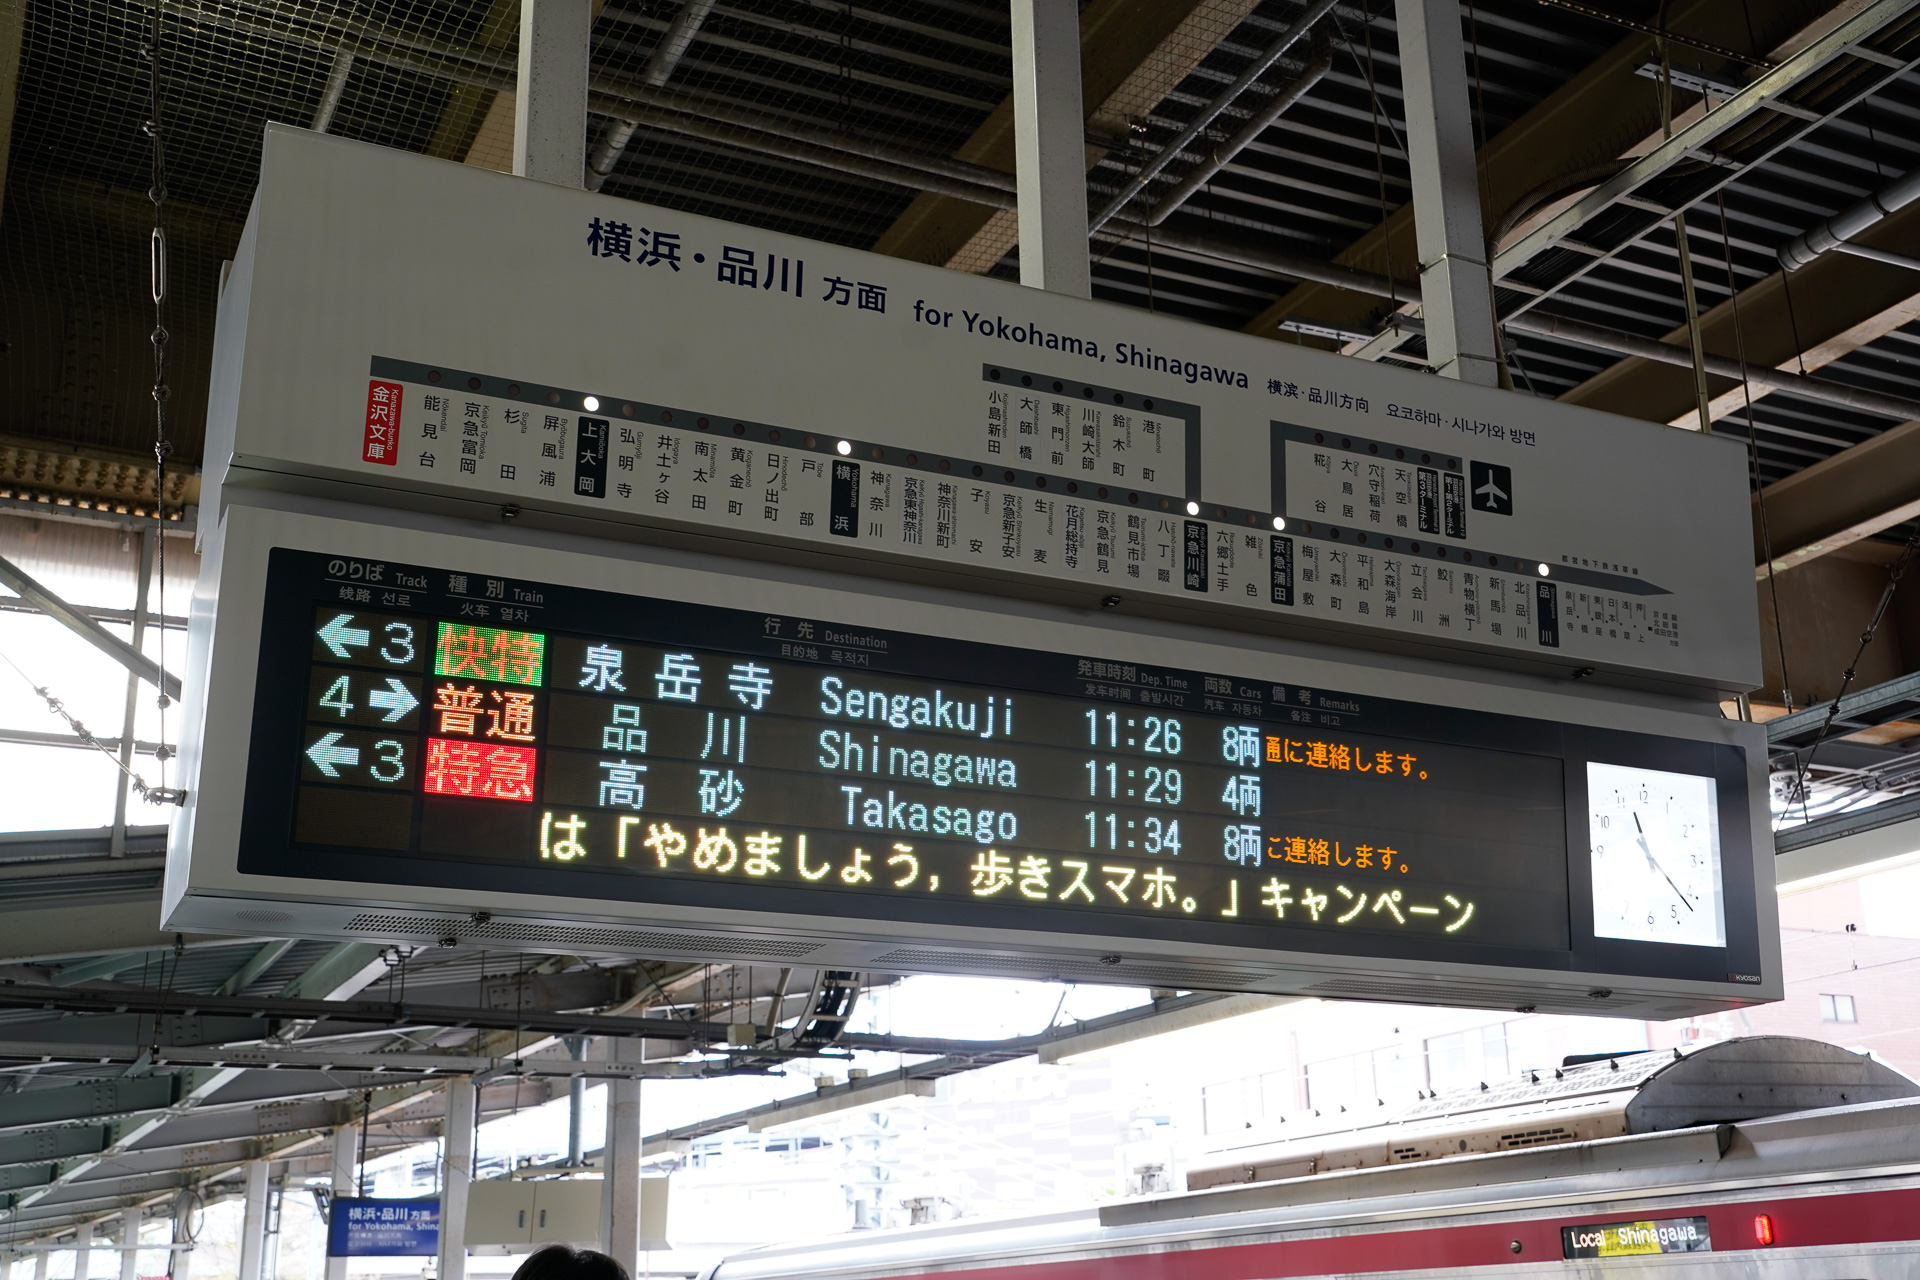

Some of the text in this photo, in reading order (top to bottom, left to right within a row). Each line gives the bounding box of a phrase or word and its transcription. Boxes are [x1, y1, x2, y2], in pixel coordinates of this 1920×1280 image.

[587, 217, 887, 314] 横浜・品川 方面
[913, 300, 1249, 389] for Yokohama, Shinagawa
[367, 385, 390, 460] 金沢文庫
[386, 389, 399, 451] Kanazawa-bunko
[419, 395, 441, 468] 能見台
[440, 398, 449, 432] Nōkendai
[459, 402, 481, 474] 京急富岡
[520, 412, 530, 434] Sugita
[558, 418, 568, 460] Byōbugaura
[597, 425, 607, 460] Kamiōoka
[988, 390, 1001, 454] 小島新田
[1019, 397, 1033, 461] 大師橋
[1051, 402, 1064, 466] 東門前
[1082, 408, 1095, 471] 川崎大師
[1509, 428, 1536, 447] 방면
[478, 430, 488, 460] Tomioka
[500, 408, 521, 480] 杉田
[538, 415, 560, 487] 屏風浦
[578, 422, 599, 494] 上大岡
[616, 428, 635, 499] 弘明寺
[672, 437, 681, 465] Idogaya
[816, 462, 824, 478] Tobe
[1112, 413, 1126, 477] 鈴木町
[1142, 419, 1155, 482] 港町
[691, 441, 710, 511] 南太田
[728, 447, 746, 516] 黄金町
[764, 453, 780, 522] 日ノ出町
[799, 458, 816, 527] 戸部
[834, 464, 852, 532] 横浜
[850, 468, 860, 508] Yokohama
[869, 470, 885, 538] 神奈川
[884, 473, 892, 508] Kanagawa
[1341, 459, 1353, 518] 大鳥居
[1369, 464, 1380, 523] 穴守稲荷
[1395, 468, 1408, 528] 天空橋
[902, 476, 918, 544] 京急東神奈川
[936, 482, 951, 549] 神奈川新町
[969, 487, 984, 554] 子安
[1002, 493, 1016, 559] 京急新子安
[1033, 499, 1048, 564] 生麦
[1064, 504, 1079, 569] 花月総持寺
[328, 560, 385, 581] のりば
[1097, 510, 1110, 574] 京急鶴見
[1127, 514, 1140, 579] 鶴見市場
[1187, 524, 1200, 588] 京急川崎
[1217, 530, 1229, 592] 六郷土手
[1245, 535, 1257, 597] 雑色
[1273, 539, 1286, 602] 京急蒲田
[339, 586, 371, 603] 线路
[381, 592, 411, 607] 선로
[396, 573, 428, 588] Track
[513, 588, 544, 603] Train
[1302, 544, 1314, 606] 梅屋敷
[1329, 550, 1342, 610] 大森町
[1357, 554, 1370, 615] 平和島
[1384, 559, 1397, 618] 大森海岸
[1411, 563, 1423, 623] 立会川
[1463, 572, 1476, 630] 青物横丁
[460, 602, 490, 617] 火车
[501, 607, 529, 622] 열차
[1489, 577, 1502, 635] 新馬場
[1514, 581, 1527, 640] 北品川
[1539, 585, 1552, 643] 品川
[381, 622, 414, 663] 3
[438, 624, 541, 683] 快特
[781, 644, 818, 660] 目的地
[825, 630, 887, 648] Destination
[831, 650, 869, 666] 목적지
[319, 675, 353, 717] 4
[1078, 660, 1136, 682] 発車時刻
[1085, 683, 1131, 700] 发车时间
[1140, 690, 1184, 706] 출발시간
[1141, 673, 1188, 688] Dep. Time
[1204, 678, 1232, 695] 両数
[1240, 687, 1262, 699] Cars
[433, 682, 535, 742] 普通
[821, 676, 1012, 738] Sengakuji
[1085, 709, 1182, 755] 11:26
[1204, 699, 1225, 711] 汽车
[1232, 703, 1262, 716] 자동차
[1291, 711, 1311, 723] 备注
[1320, 697, 1360, 712] Remarks
[1321, 715, 1340, 726] 비고
[370, 739, 404, 782] 3
[428, 741, 532, 798] 特急
[819, 729, 1017, 788] Shinagawa
[1222, 725, 1260, 769] 8両
[1085, 760, 1182, 805] 11:29
[1221, 774, 1261, 818] 4両
[1639, 790, 1649, 804] 12
[841, 786, 1017, 844] Takasago
[1085, 811, 1182, 856] 11:34
[1600, 815, 1610, 829] 10
[1683, 824, 1689, 838] 2
[1223, 824, 1262, 868] 8両
[1596, 845, 1604, 858] 9
[1690, 854, 1697, 868] 3
[1647, 910, 1655, 924] 6
[1670, 904, 1677, 919] 5
[348, 1207, 431, 1221] 横浜・品川 方面
[348, 1222, 362, 1231] for
[365, 1222, 413, 1232] Yokohama,
[1571, 1229, 1606, 1249] Local
[1617, 1225, 1698, 1247] Shinagawa
